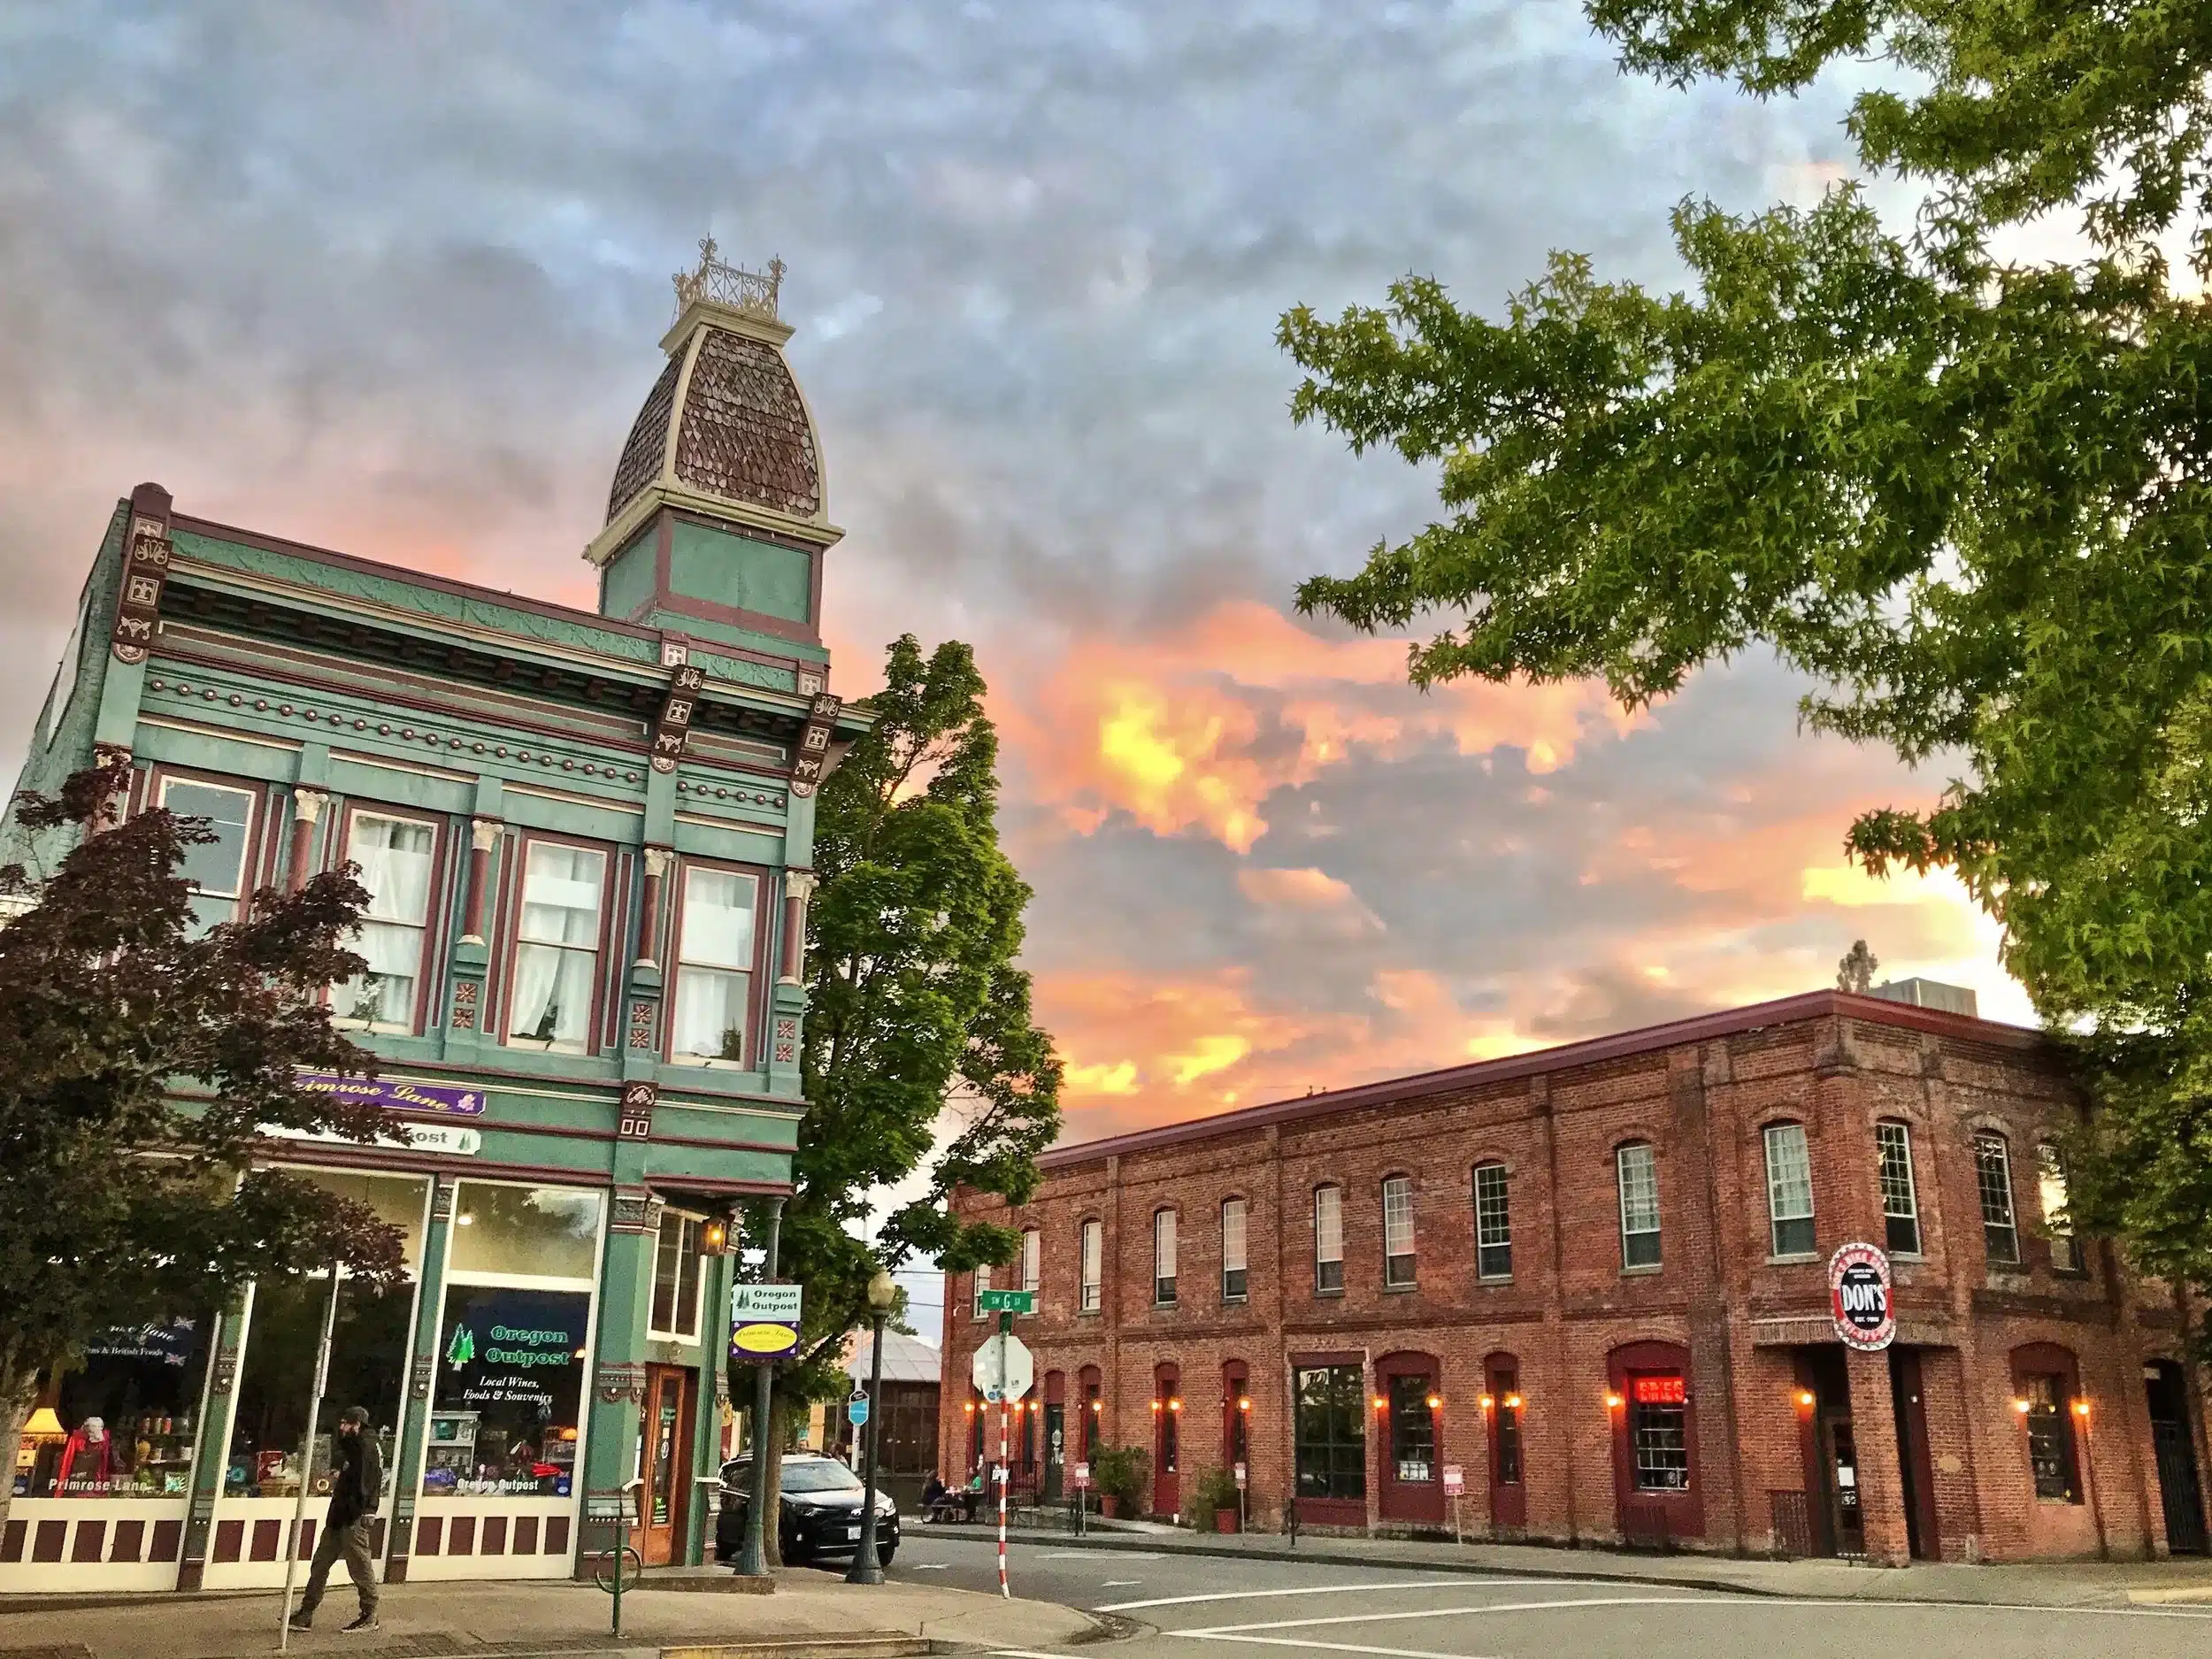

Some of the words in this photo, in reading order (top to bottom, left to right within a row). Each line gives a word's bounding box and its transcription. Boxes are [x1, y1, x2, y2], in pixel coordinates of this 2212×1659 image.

[390, 1084, 452, 1111] Lane
[754, 1290, 796, 1299] Oregon
[1003, 1294, 1010, 1309] G
[1841, 1284, 1886, 1311] DON'S
[752, 1302, 797, 1312] Outpost
[490, 1325, 569, 1346] Oregon
[111, 1347, 138, 1356] British
[140, 1348, 163, 1356] Foods
[485, 1348, 570, 1368] Outpost
[479, 1375, 506, 1386] Local
[508, 1376, 540, 1389] Wines,
[463, 1389, 489, 1400] Foods
[492, 1390, 503, 1401] &
[504, 1390, 553, 1403] Souvenirs
[49, 1479, 110, 1491] Primrose
[115, 1479, 149, 1492] Lane
[457, 1478, 495, 1493] Oregon
[498, 1479, 538, 1493] Outpost
